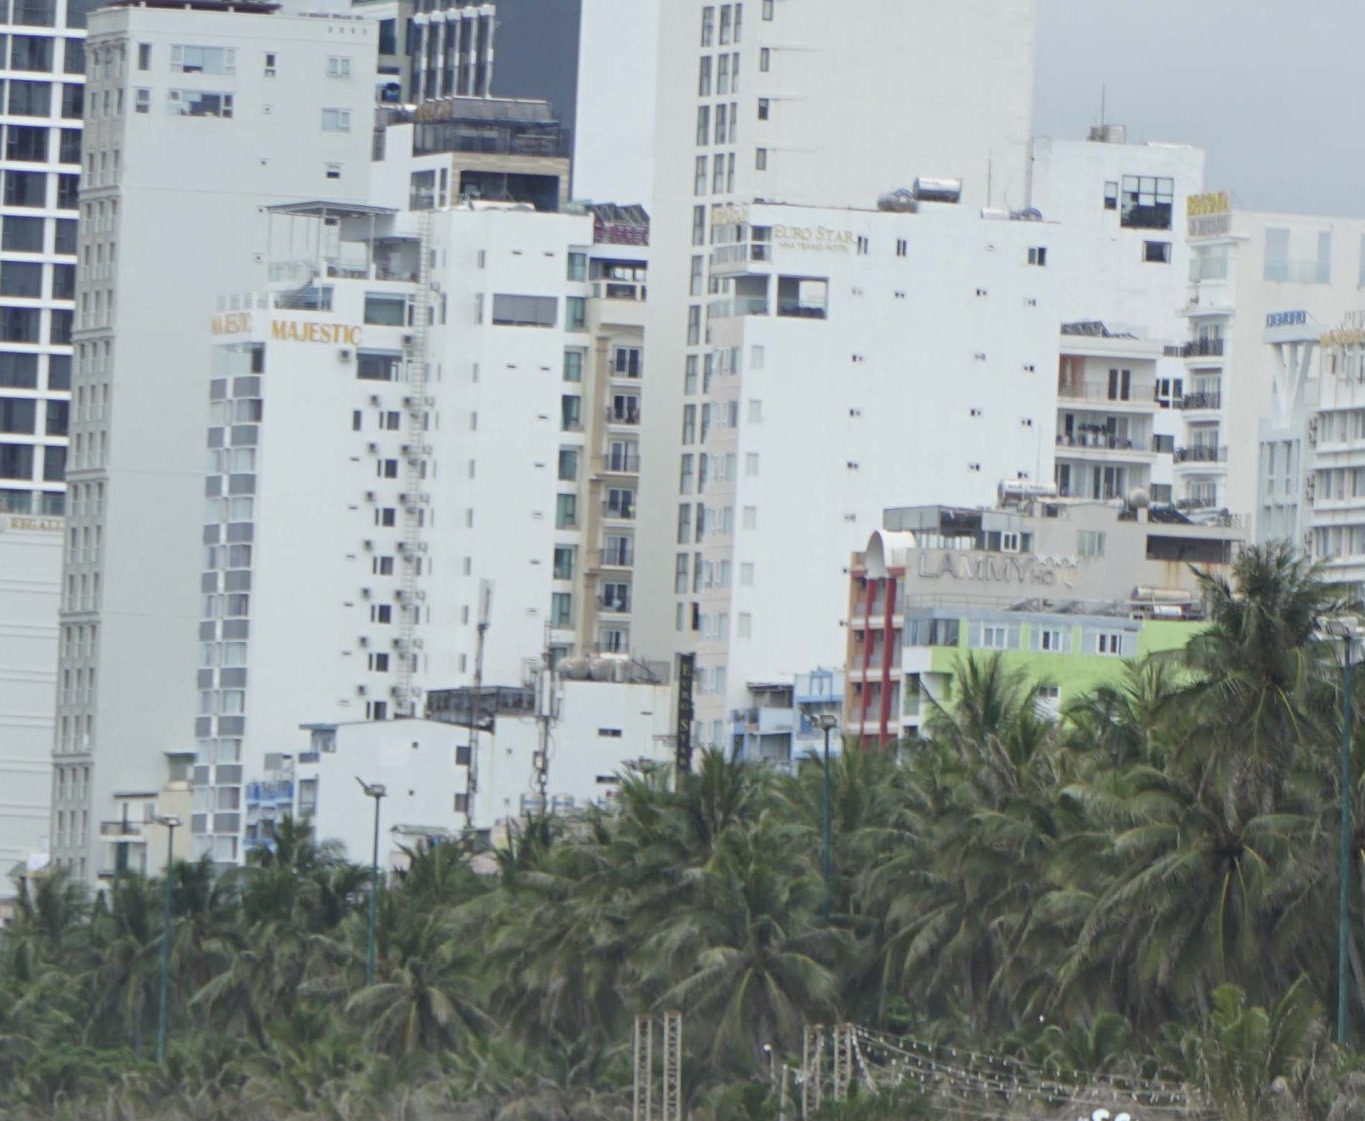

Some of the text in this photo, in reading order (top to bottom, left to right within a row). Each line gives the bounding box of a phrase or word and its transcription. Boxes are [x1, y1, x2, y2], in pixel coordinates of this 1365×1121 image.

[815, 225, 855, 245] STAR
[271, 319, 362, 346] MAJESTIC
[919, 552, 1034, 583] LAMMY
